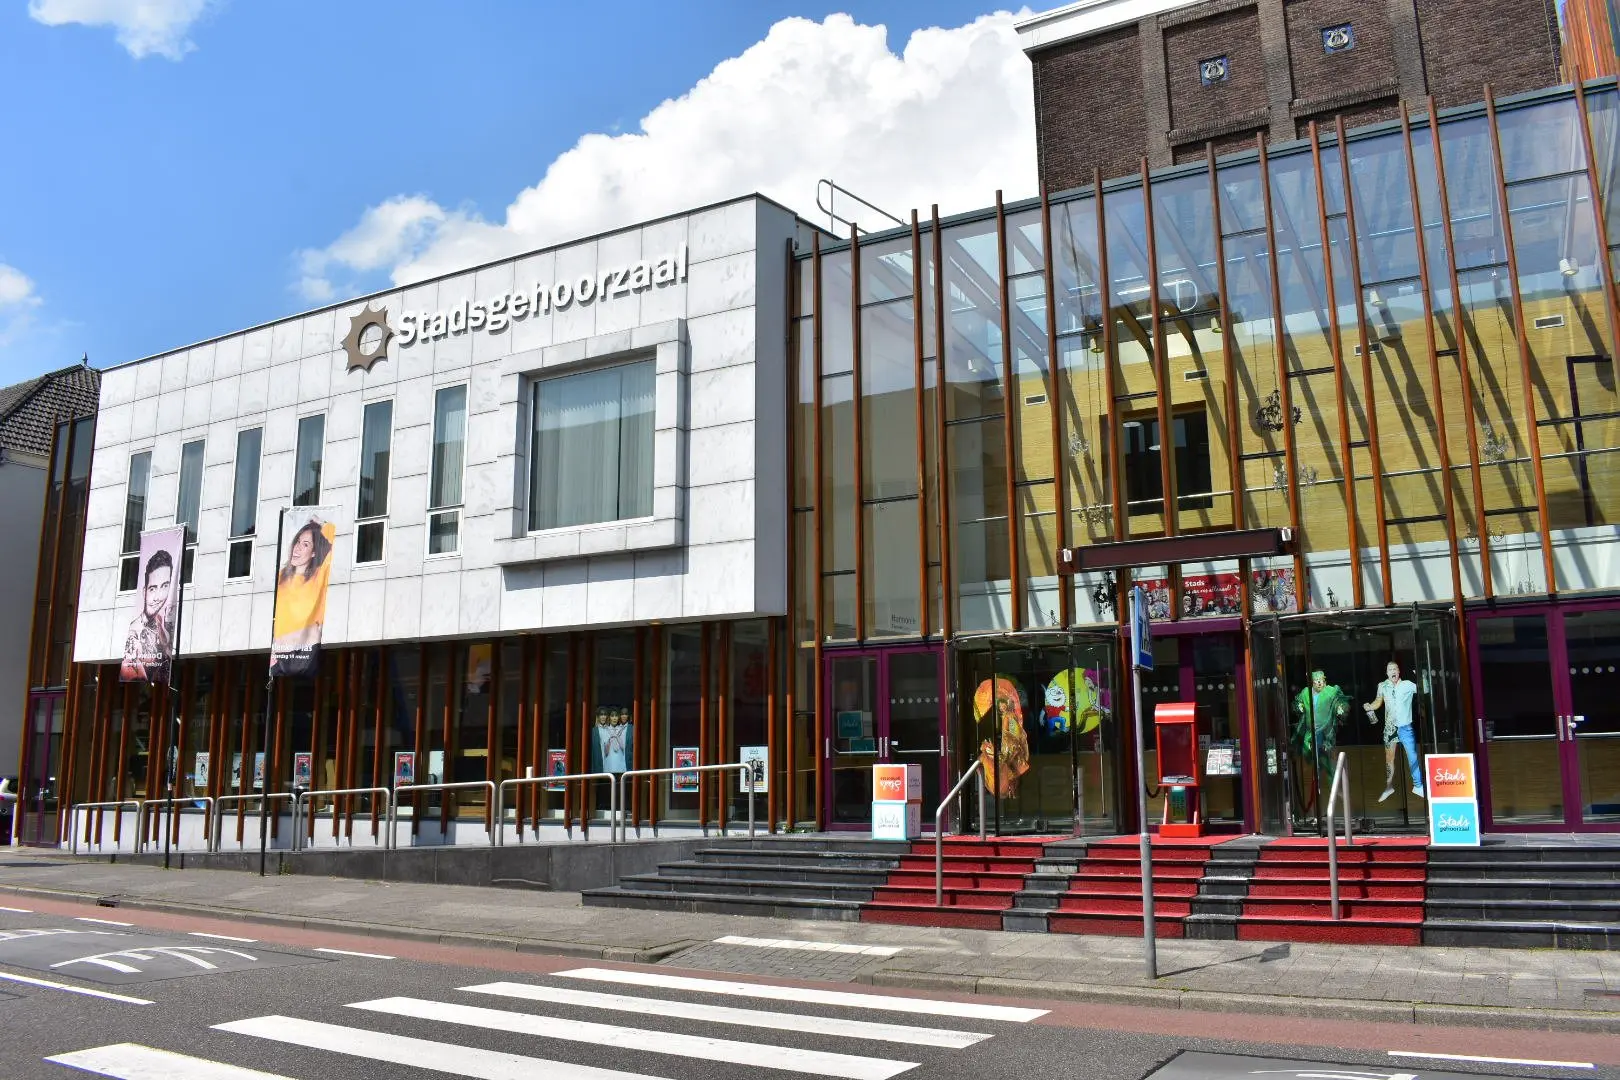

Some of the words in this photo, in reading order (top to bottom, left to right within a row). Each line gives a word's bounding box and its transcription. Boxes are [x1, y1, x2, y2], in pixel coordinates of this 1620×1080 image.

[397, 240, 688, 346] Stadsgehoorzaal
[1434, 767, 1467, 782] Stads
[1438, 813, 1470, 827] Stads
